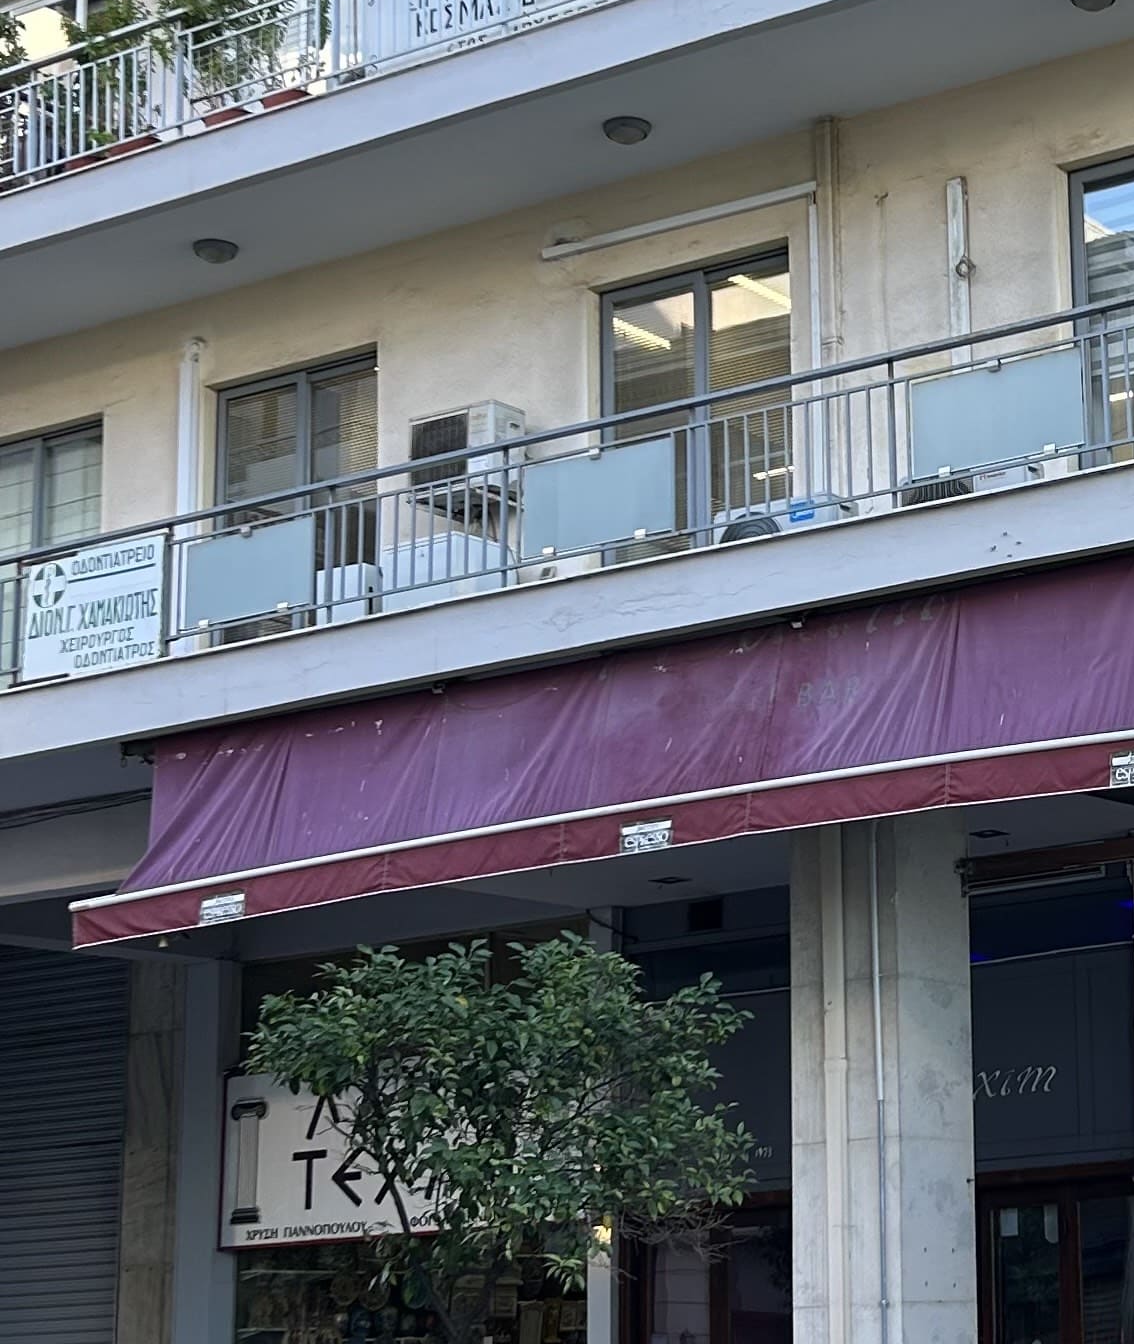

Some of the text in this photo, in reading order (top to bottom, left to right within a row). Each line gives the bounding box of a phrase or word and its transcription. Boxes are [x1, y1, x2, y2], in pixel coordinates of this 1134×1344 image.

[71, 543, 156, 576] ΟΔΟΝΤΙΑΤΡΕΙΟ
[59, 626, 135, 654] ΧΕΙΡΟΥΡΓΟΣ
[73, 641, 156, 669] ΟΔΟΝΤΙΑΤΡΟΣ
